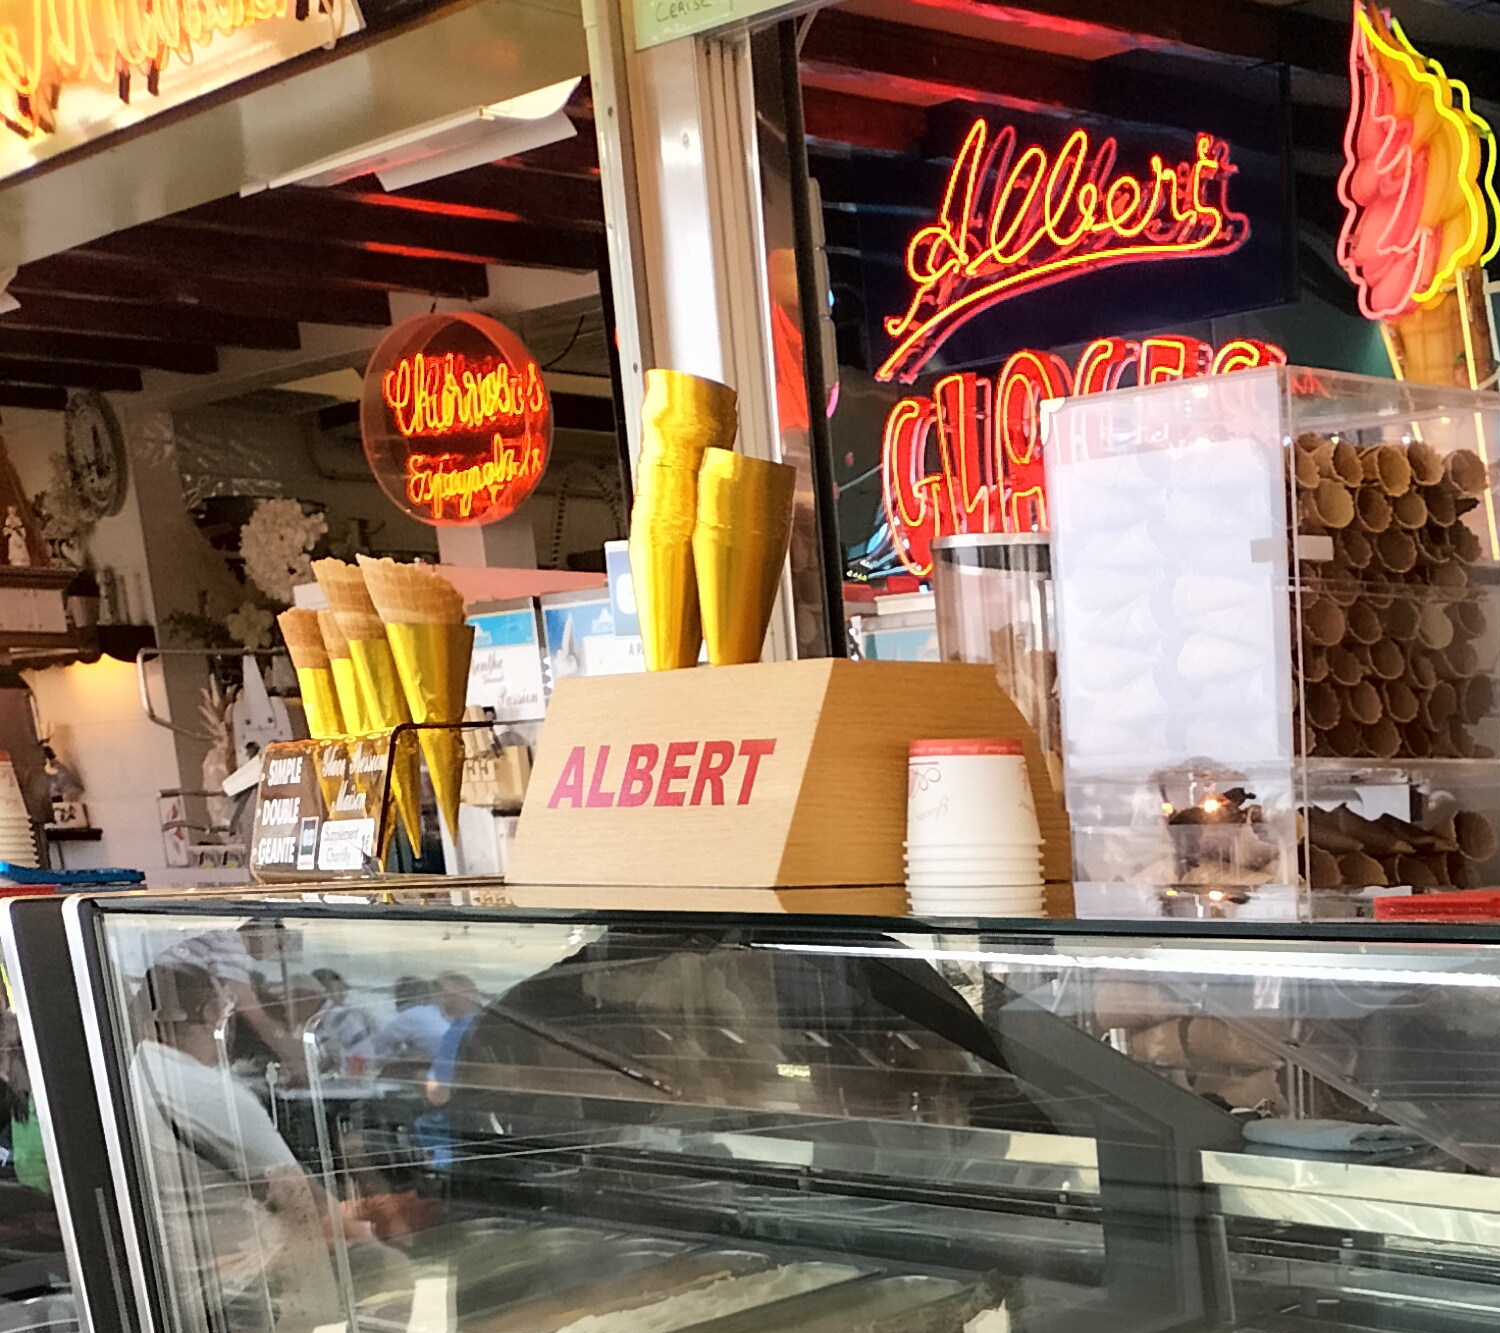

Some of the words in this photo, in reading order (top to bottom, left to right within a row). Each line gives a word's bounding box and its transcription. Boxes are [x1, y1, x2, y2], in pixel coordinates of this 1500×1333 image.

[268, 757, 303, 786] SIMPLE
[547, 738, 777, 808] ALBERT
[262, 797, 300, 826] DOUBLE
[258, 836, 296, 865] GEANTE
